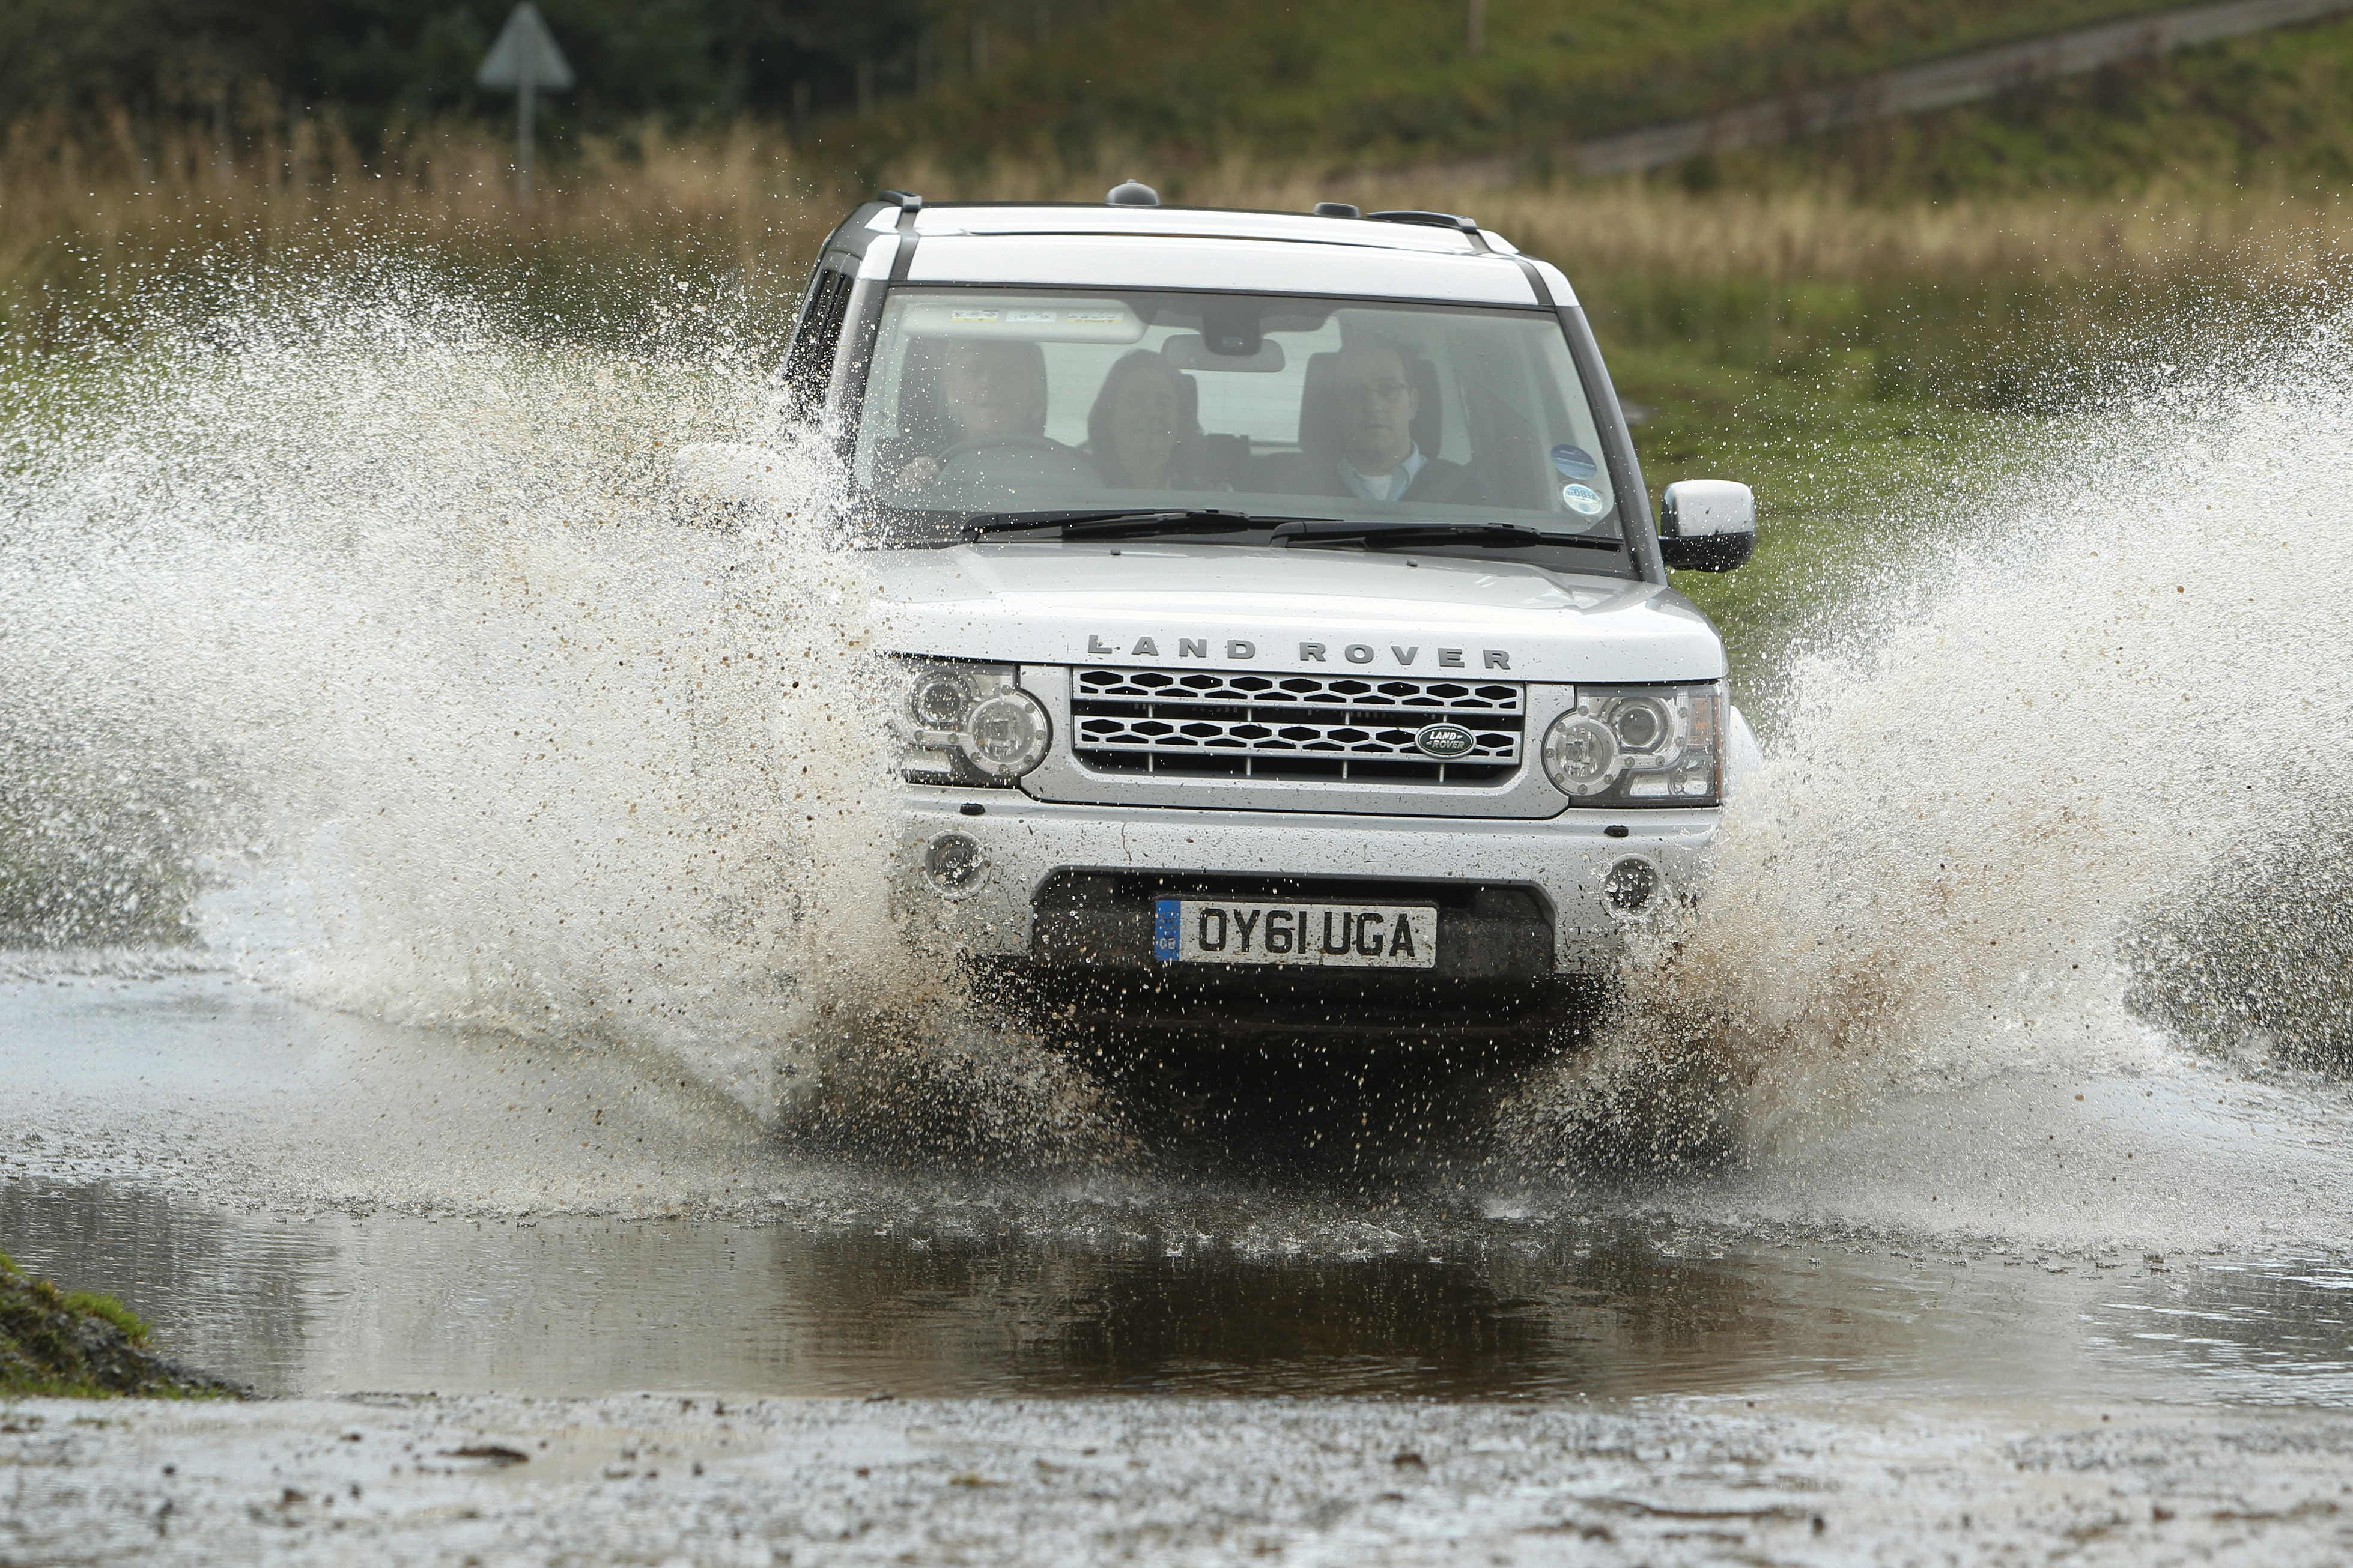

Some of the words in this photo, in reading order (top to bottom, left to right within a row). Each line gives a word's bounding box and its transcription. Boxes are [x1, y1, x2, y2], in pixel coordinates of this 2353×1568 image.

[1088, 634, 1256, 659] LAND
[1299, 641, 1511, 670] ROVER
[1429, 731, 1457, 740] LAND
[1431, 739, 1465, 749] ROVER
[1199, 908, 1307, 954] OY61
[1322, 911, 1415, 957] UGA
[1159, 937, 1176, 949] GB
